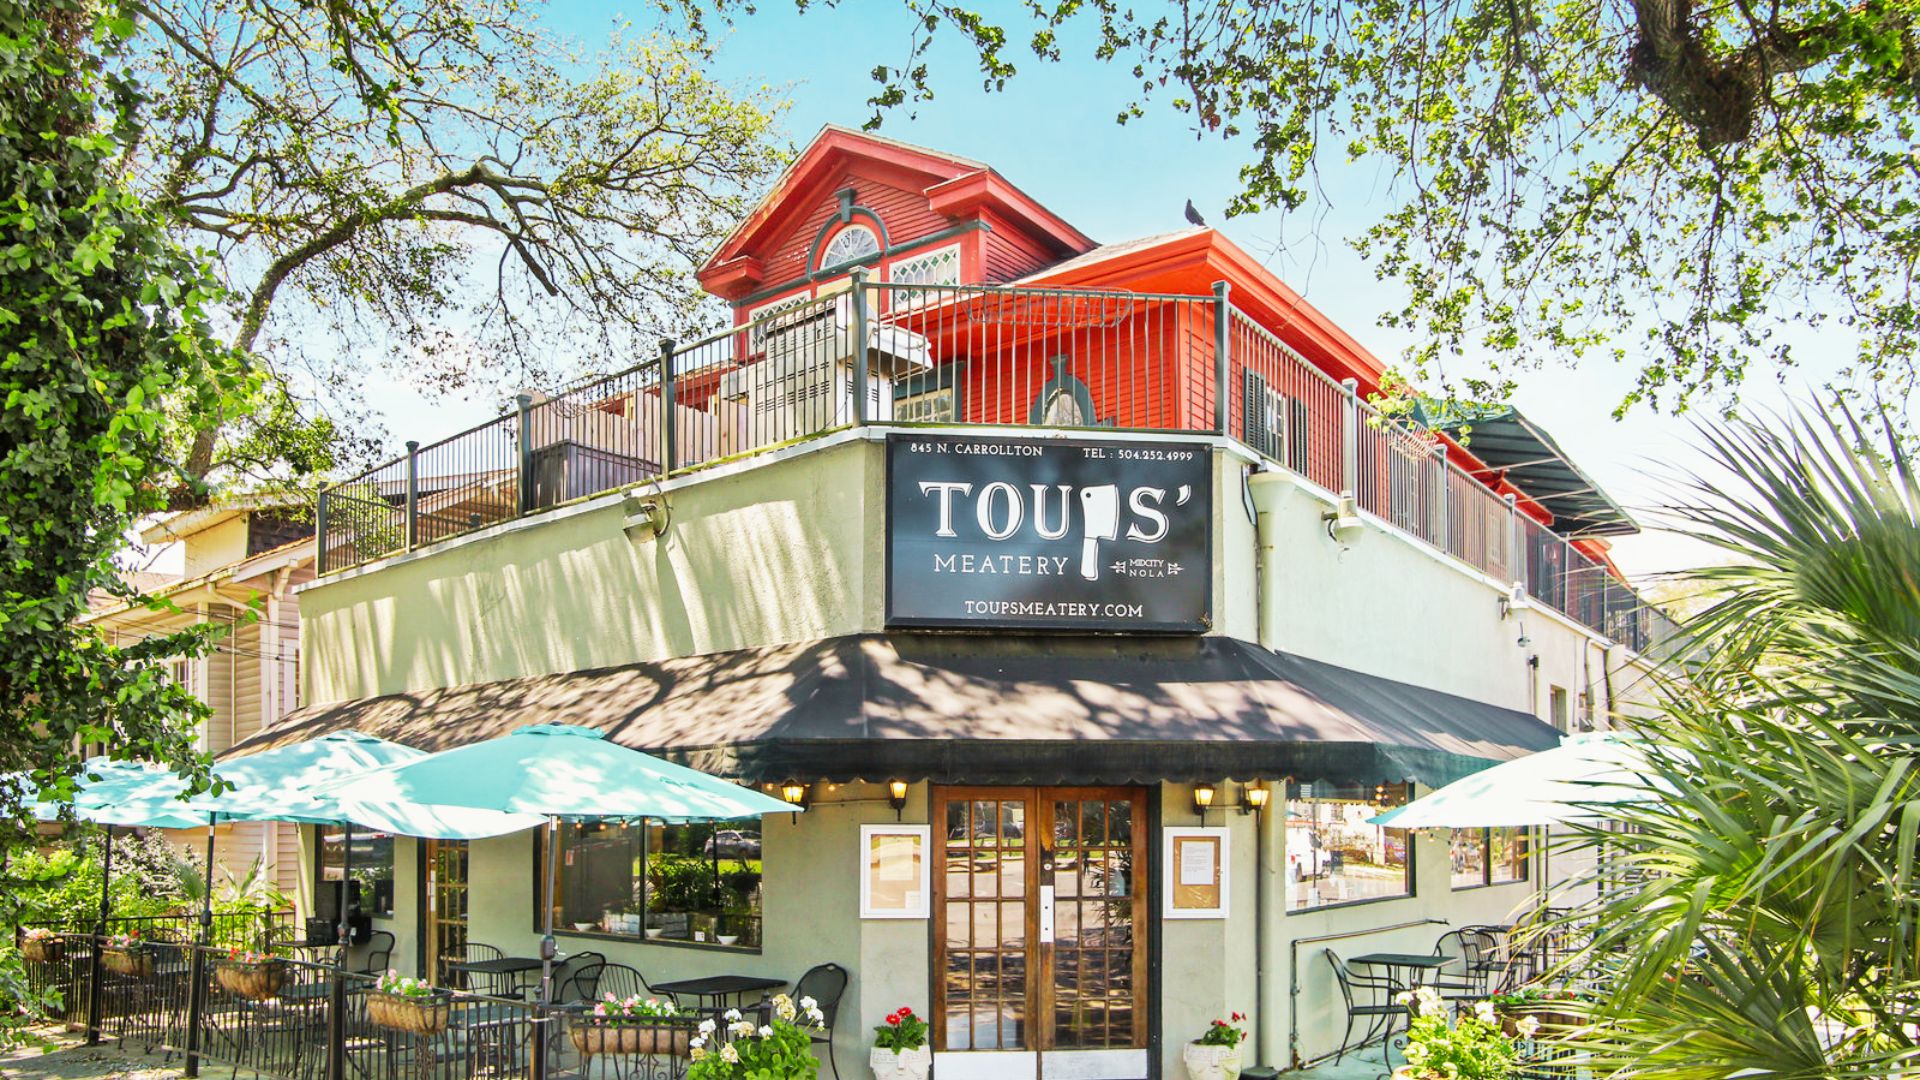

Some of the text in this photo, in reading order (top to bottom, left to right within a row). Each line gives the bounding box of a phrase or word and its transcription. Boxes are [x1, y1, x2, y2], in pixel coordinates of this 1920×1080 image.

[910, 443, 1043, 456] 845 N. CARROLLTON
[1118, 449, 1193, 461] 504.252.4999
[934, 554, 1069, 576] MEATERY
[1129, 569, 1165, 578] NOLA
[965, 600, 1143, 618] TOUPSMEATERY.COM
